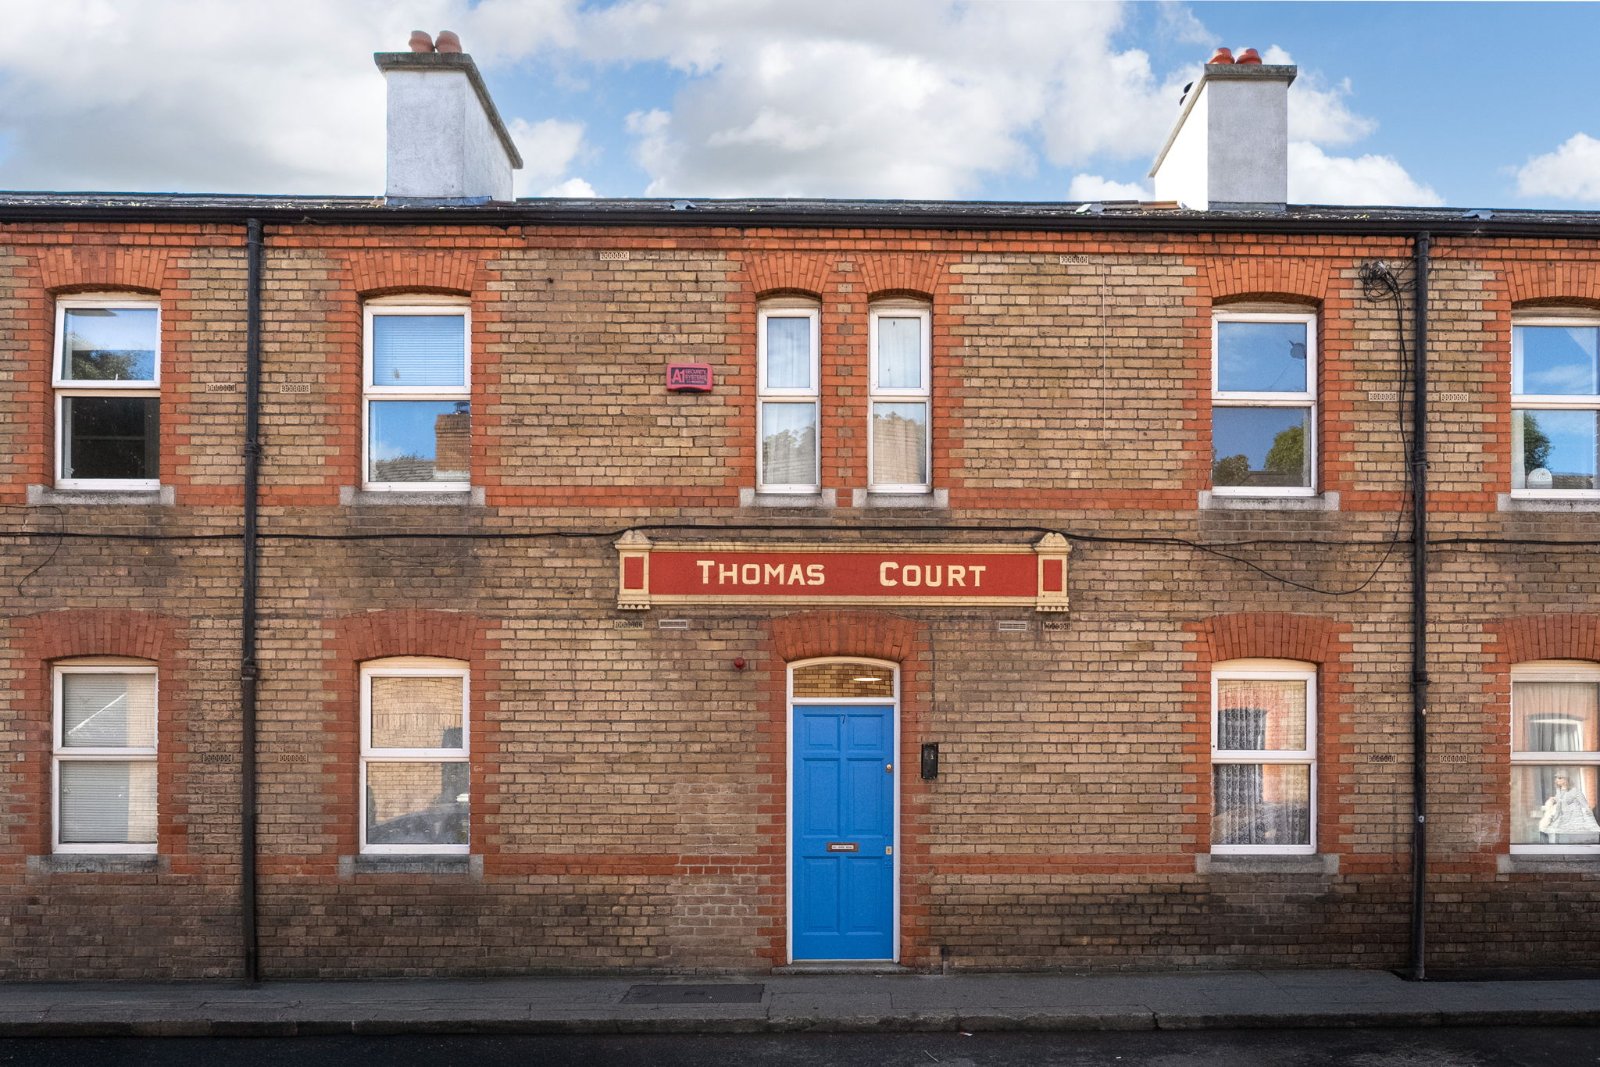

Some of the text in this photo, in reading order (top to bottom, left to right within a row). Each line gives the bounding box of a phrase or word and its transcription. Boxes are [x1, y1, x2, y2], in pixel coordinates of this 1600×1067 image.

[672, 369, 685, 383] A1
[696, 559, 987, 588] THOMAS COURT
